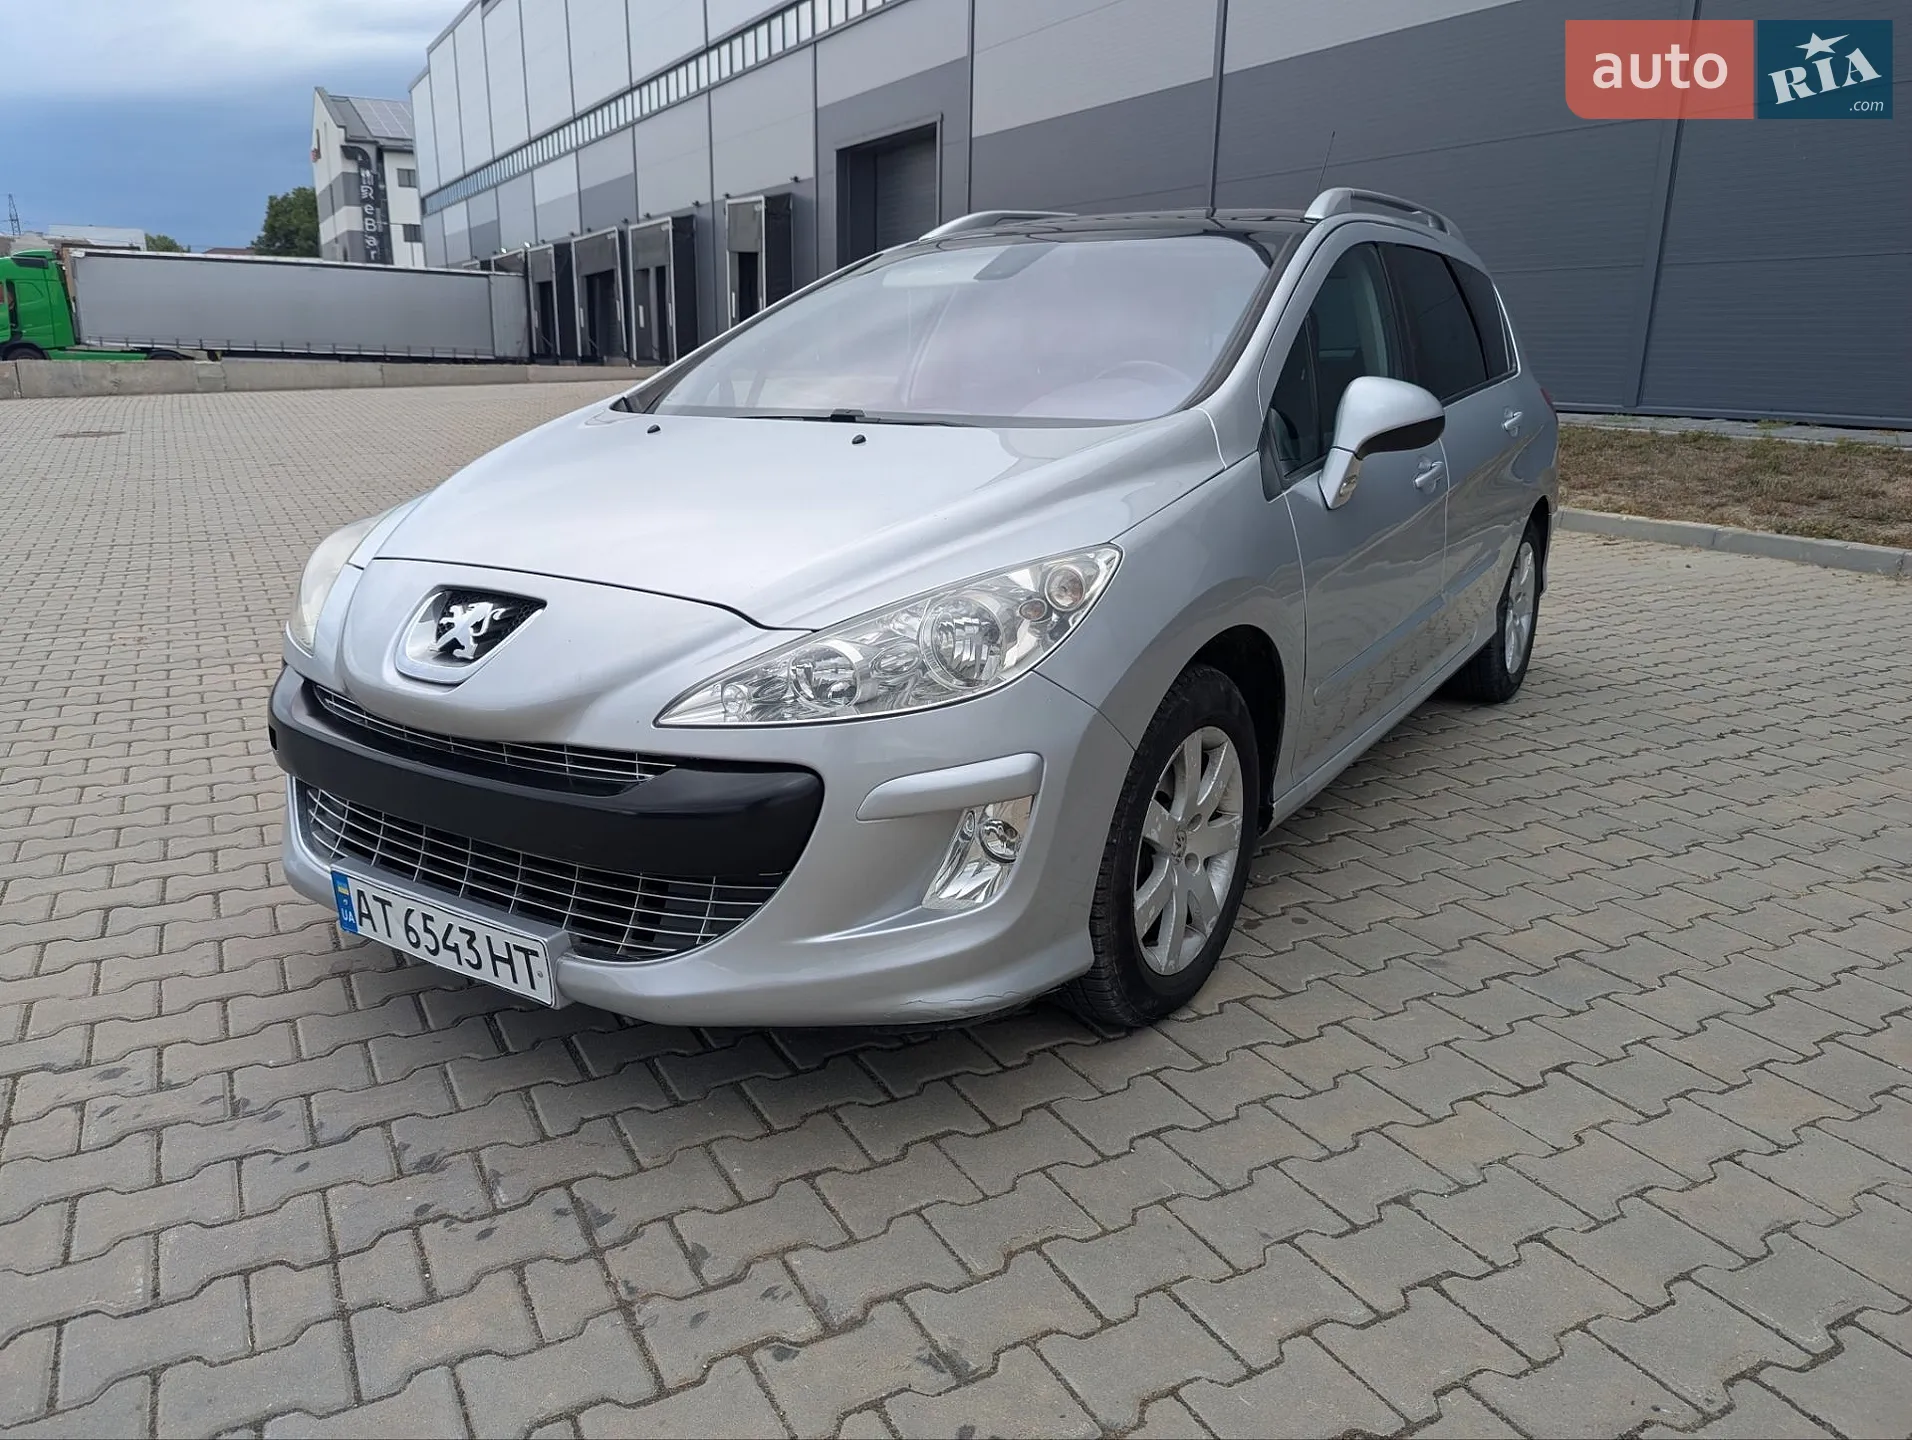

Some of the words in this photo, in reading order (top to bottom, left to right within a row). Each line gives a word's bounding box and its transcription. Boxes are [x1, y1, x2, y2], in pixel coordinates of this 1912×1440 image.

[341, 907, 356, 924] UA
[356, 889, 392, 939] AT
[404, 908, 482, 970] 6543
[486, 935, 539, 990] HT
